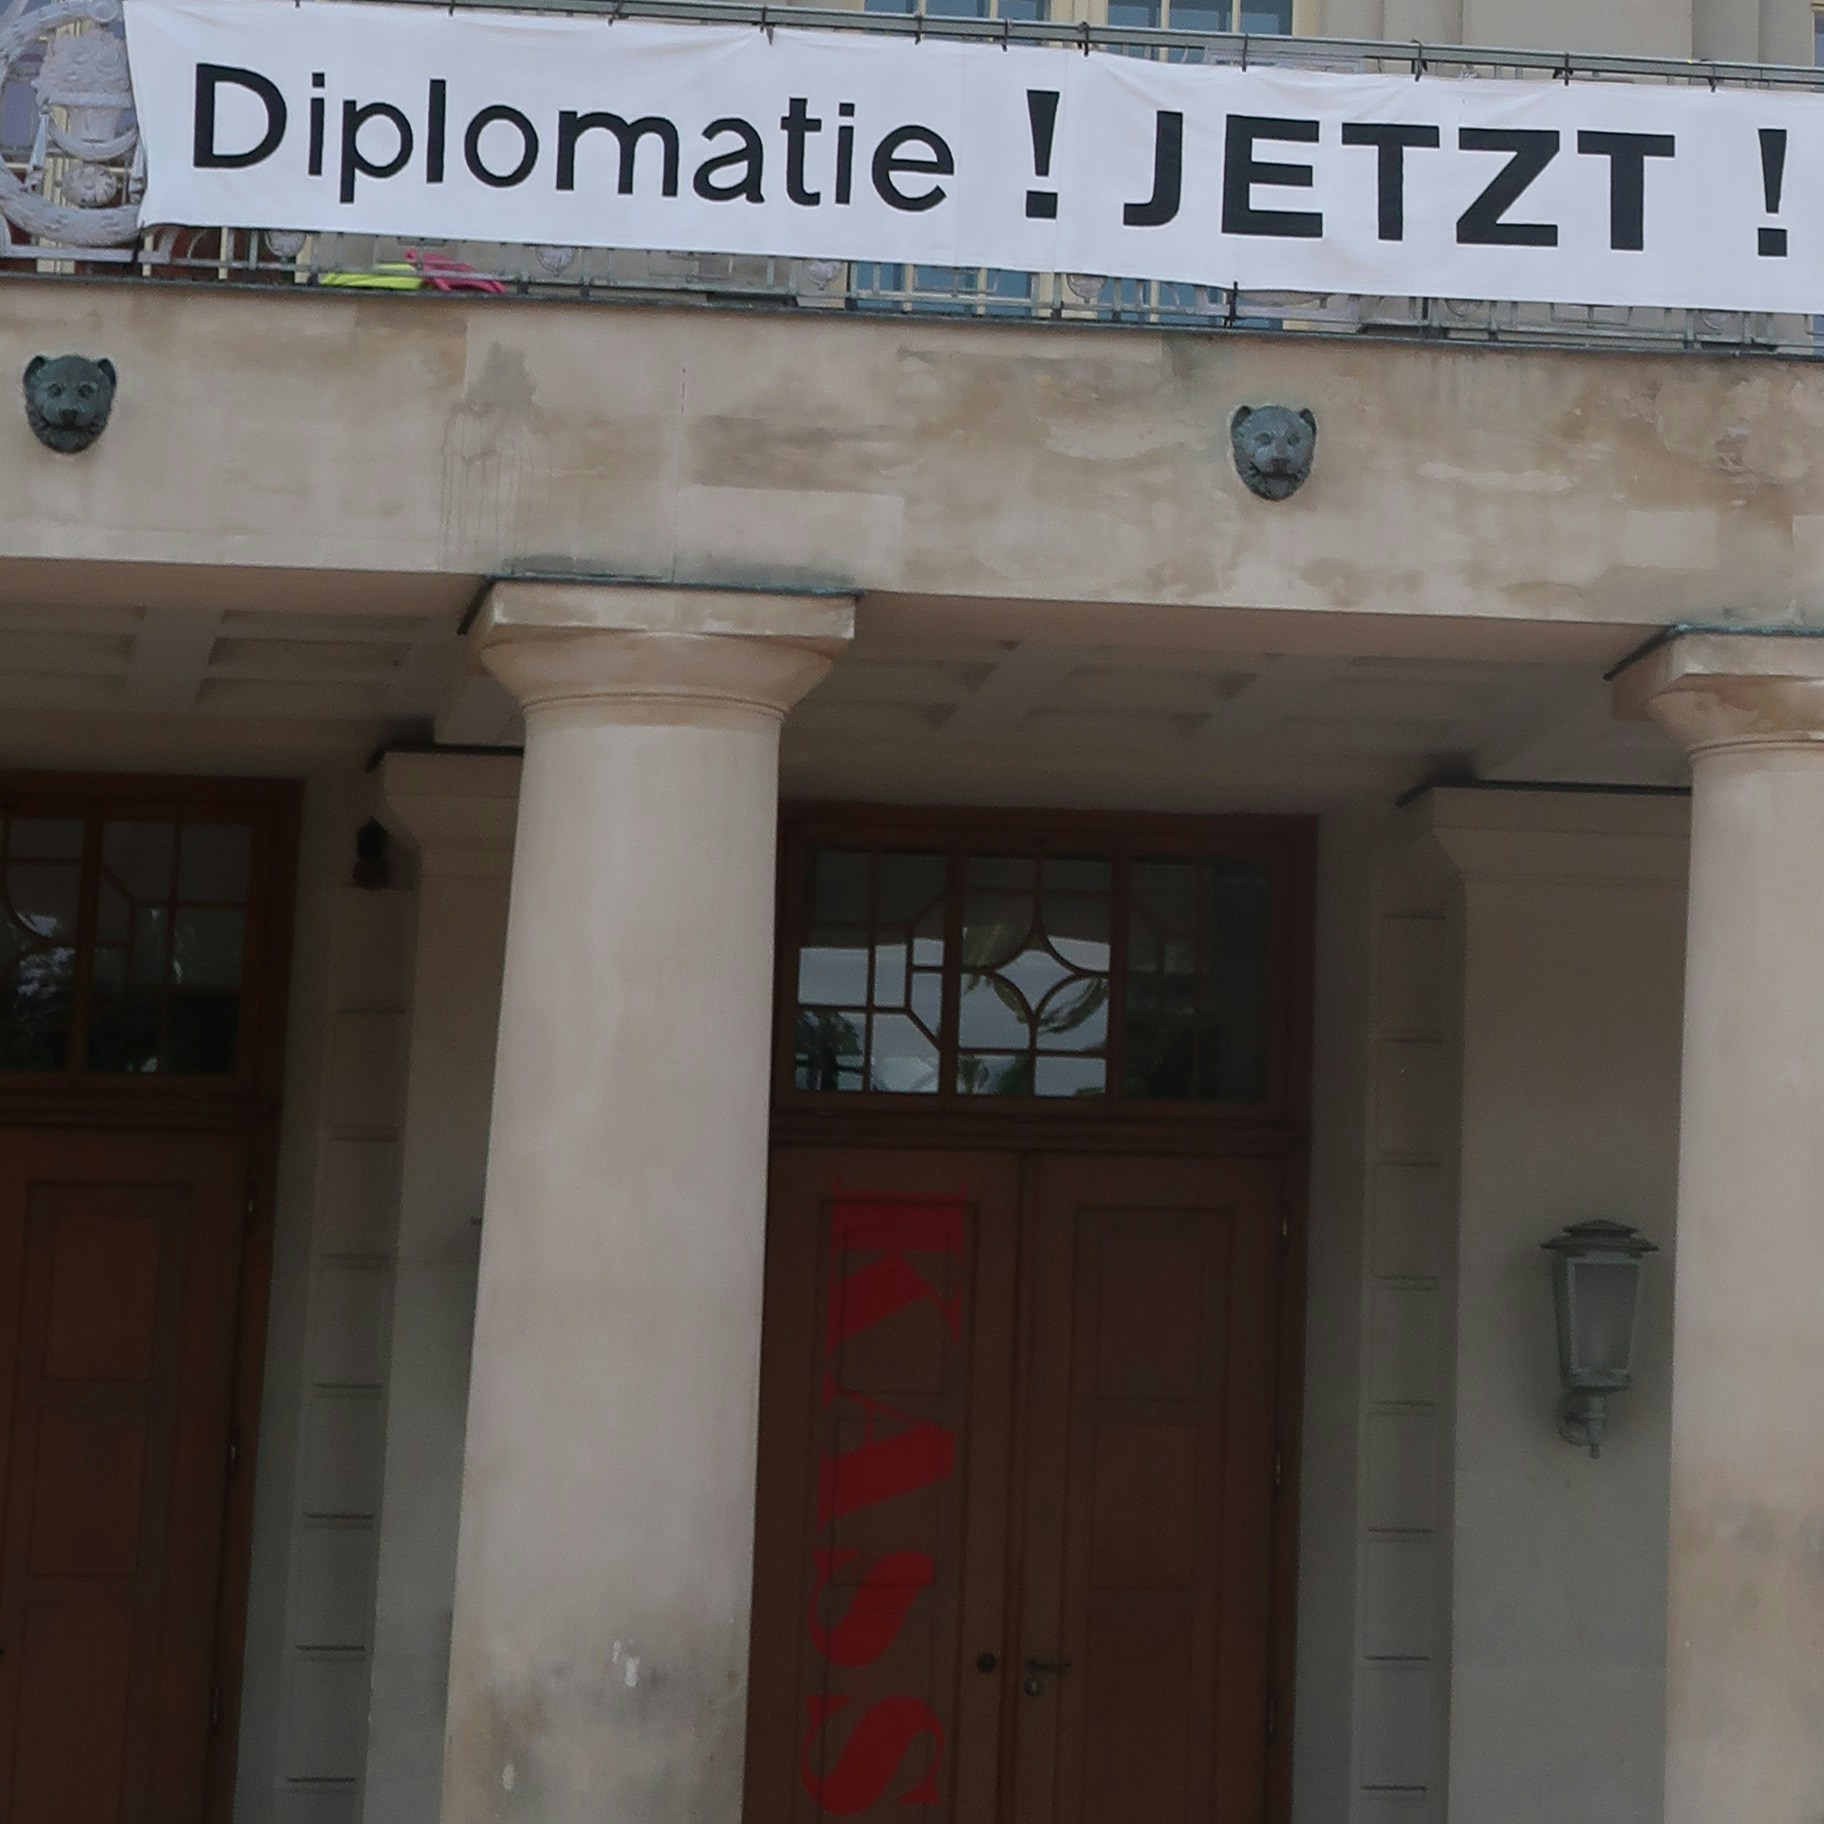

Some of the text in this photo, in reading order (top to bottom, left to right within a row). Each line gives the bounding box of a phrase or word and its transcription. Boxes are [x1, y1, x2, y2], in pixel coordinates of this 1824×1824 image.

[193, 62, 955, 212] Diplomatie
[1025, 89, 1061, 220] !
[1123, 110, 1675, 251] JETZT
[1757, 127, 1787, 257] !
